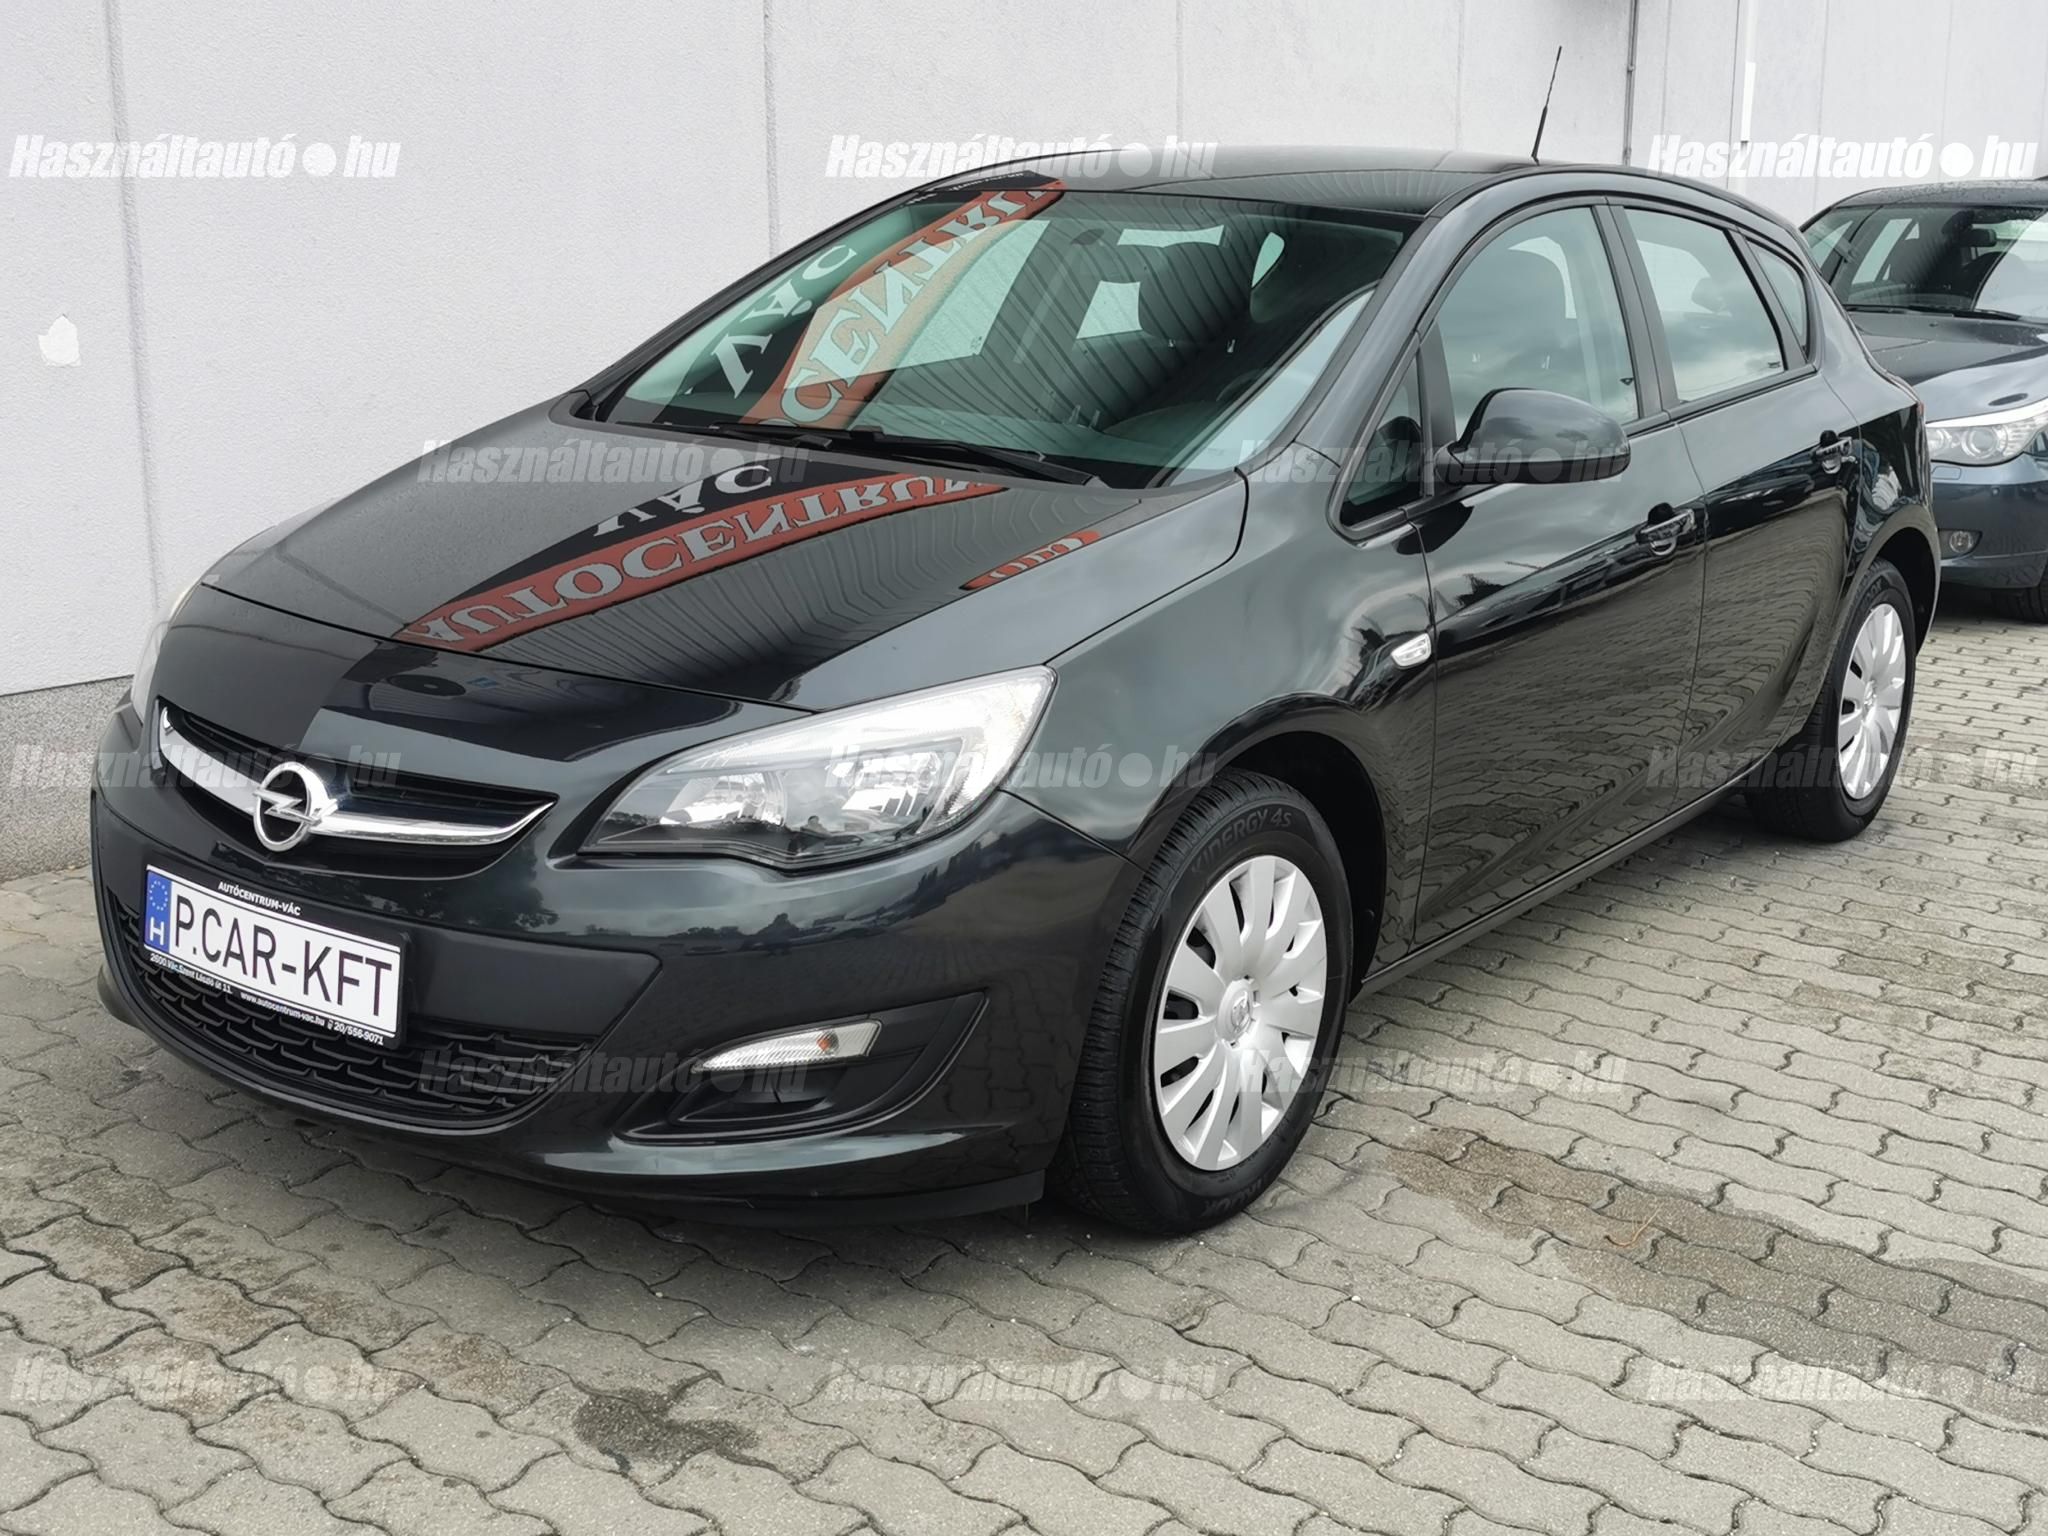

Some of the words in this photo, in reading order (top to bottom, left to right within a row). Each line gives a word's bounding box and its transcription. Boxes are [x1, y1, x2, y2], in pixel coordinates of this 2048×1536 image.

[218, 881, 301, 916] AUTÓCENTRUM-VÁC
[149, 917, 165, 945] H
[175, 894, 392, 1017] P.CAR-KFT
